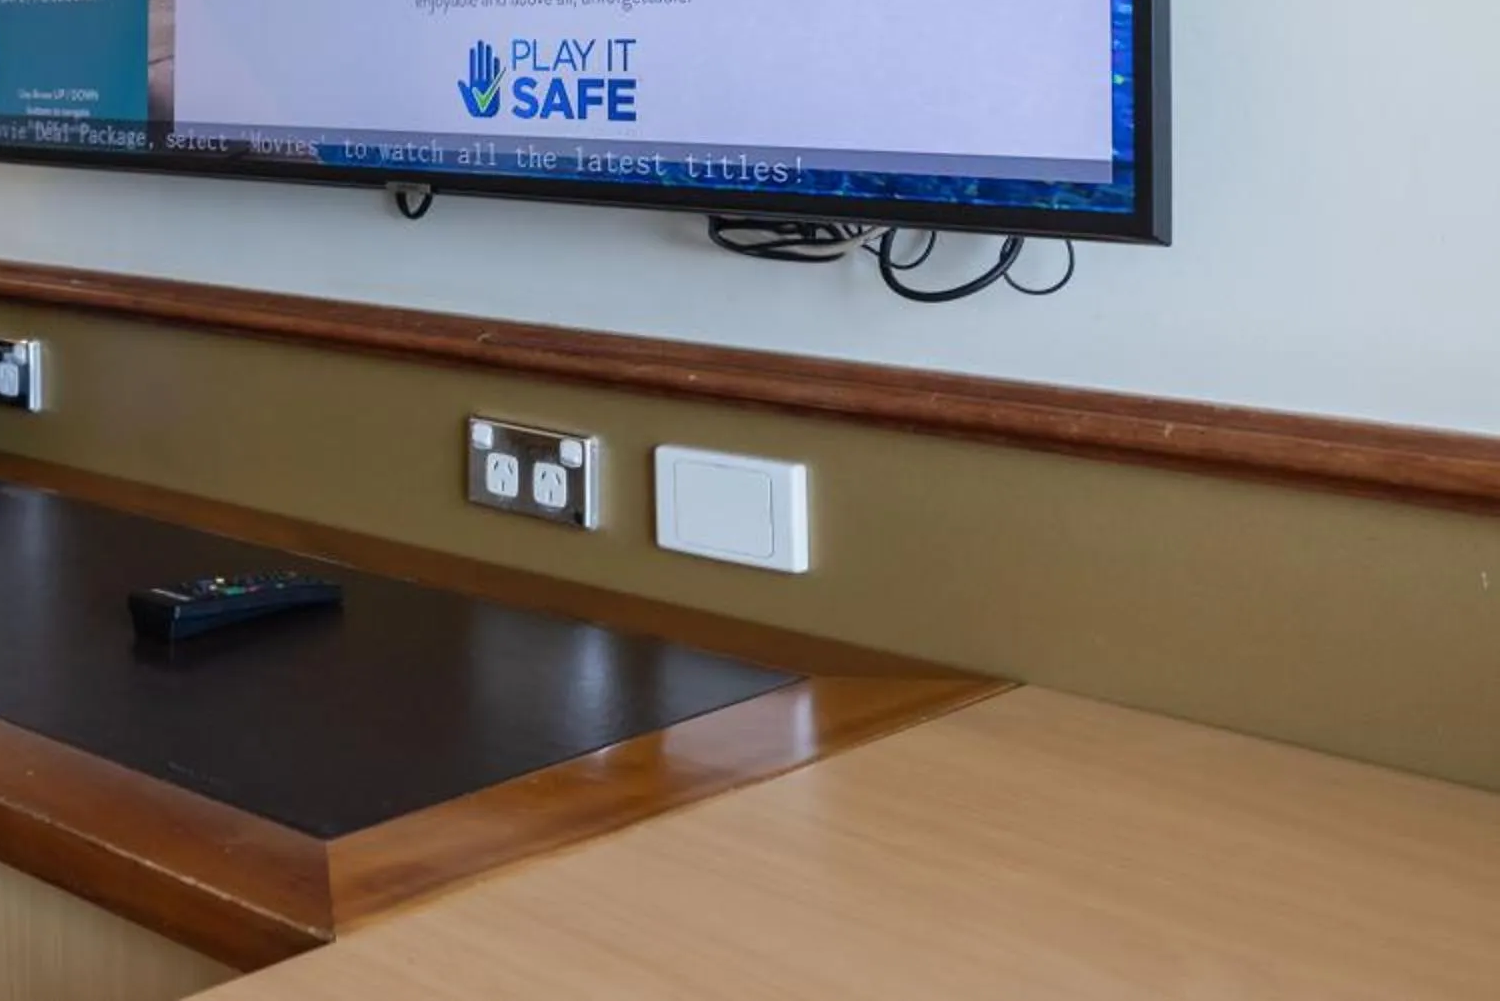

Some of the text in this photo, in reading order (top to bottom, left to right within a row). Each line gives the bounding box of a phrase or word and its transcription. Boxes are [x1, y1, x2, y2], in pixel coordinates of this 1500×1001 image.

[510, 38, 637, 72] PLAY IT
[510, 76, 637, 122] SAFE
[79, 121, 155, 150] Package,
[165, 130, 229, 152] select
[344, 140, 368, 159] to
[379, 142, 444, 164] watch
[457, 141, 498, 168] all
[515, 144, 557, 171] the
[574, 146, 668, 177] latest
[685, 154, 803, 185] titles!
